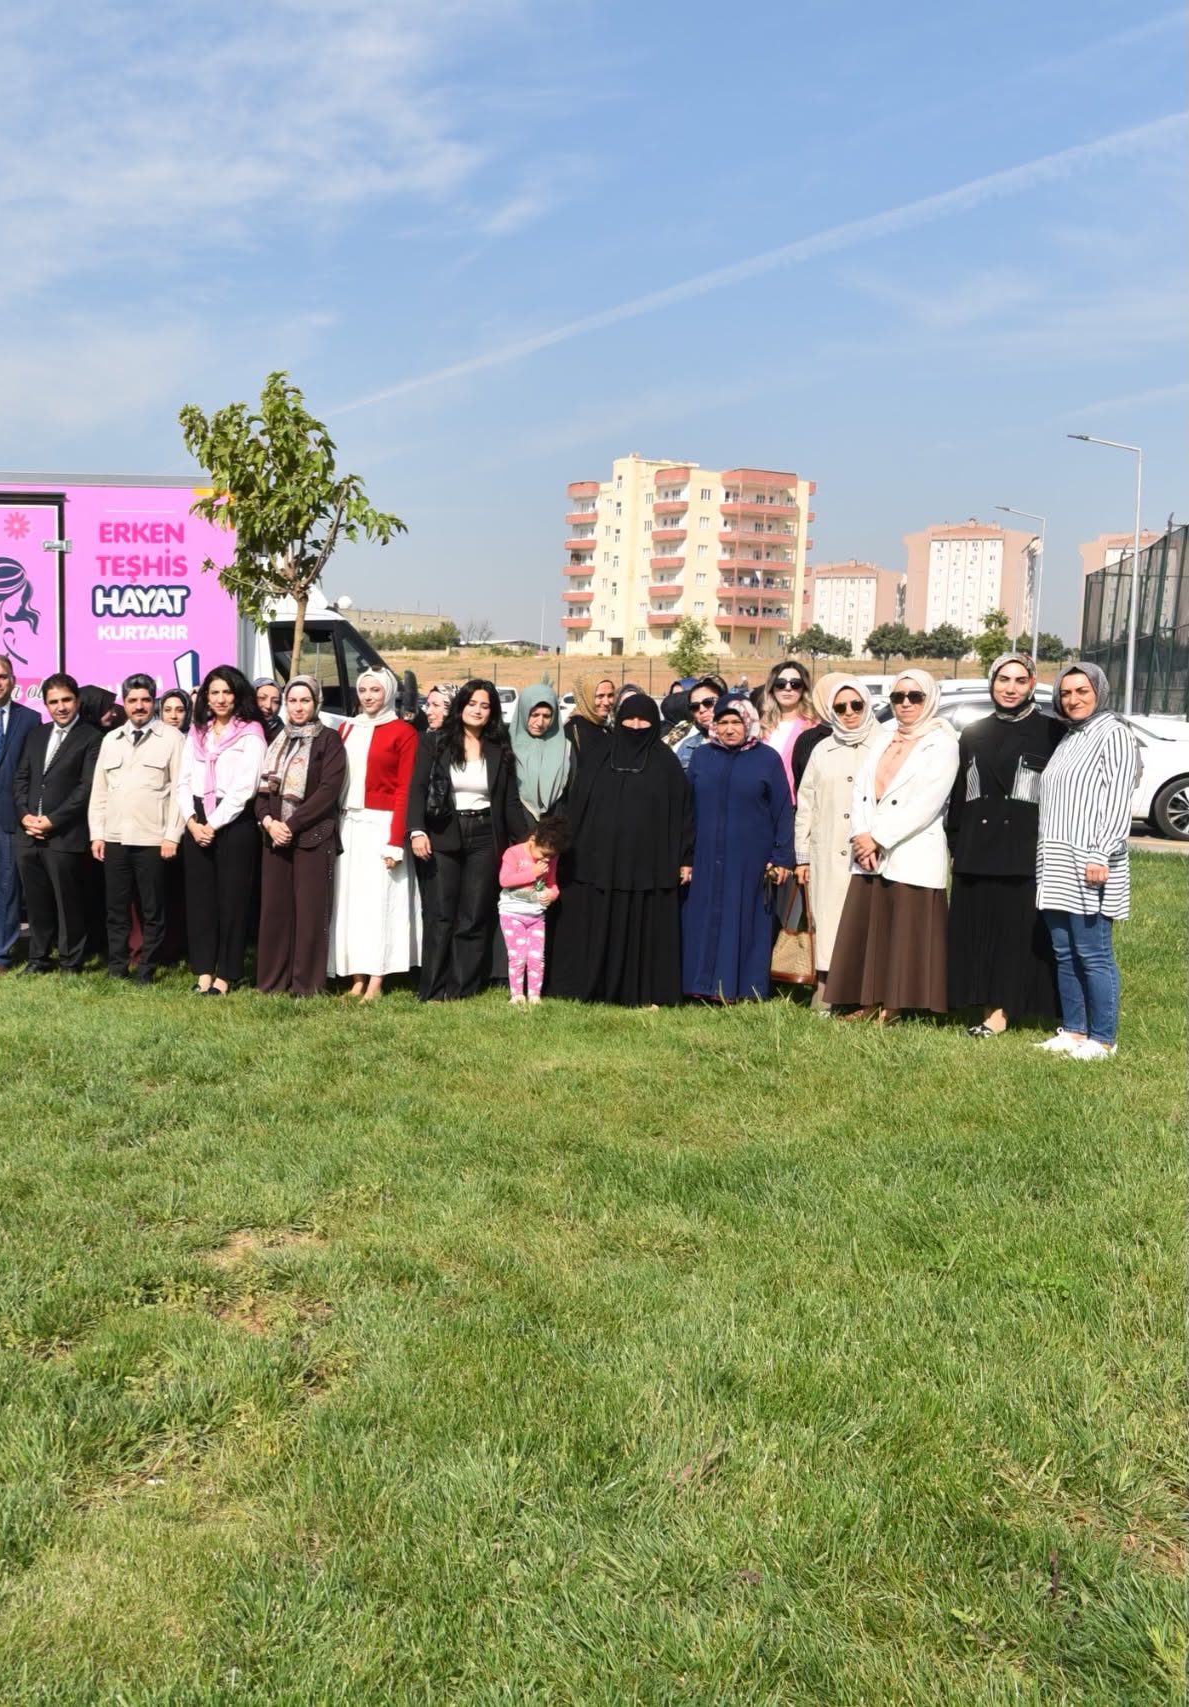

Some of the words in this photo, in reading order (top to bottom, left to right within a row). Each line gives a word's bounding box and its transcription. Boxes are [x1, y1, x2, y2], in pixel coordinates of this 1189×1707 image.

[99, 522, 185, 544] ERKEN
[95, 548, 188, 583] TEŞHİS
[94, 587, 189, 616] HAYAT
[97, 624, 188, 641] KURTARIR
